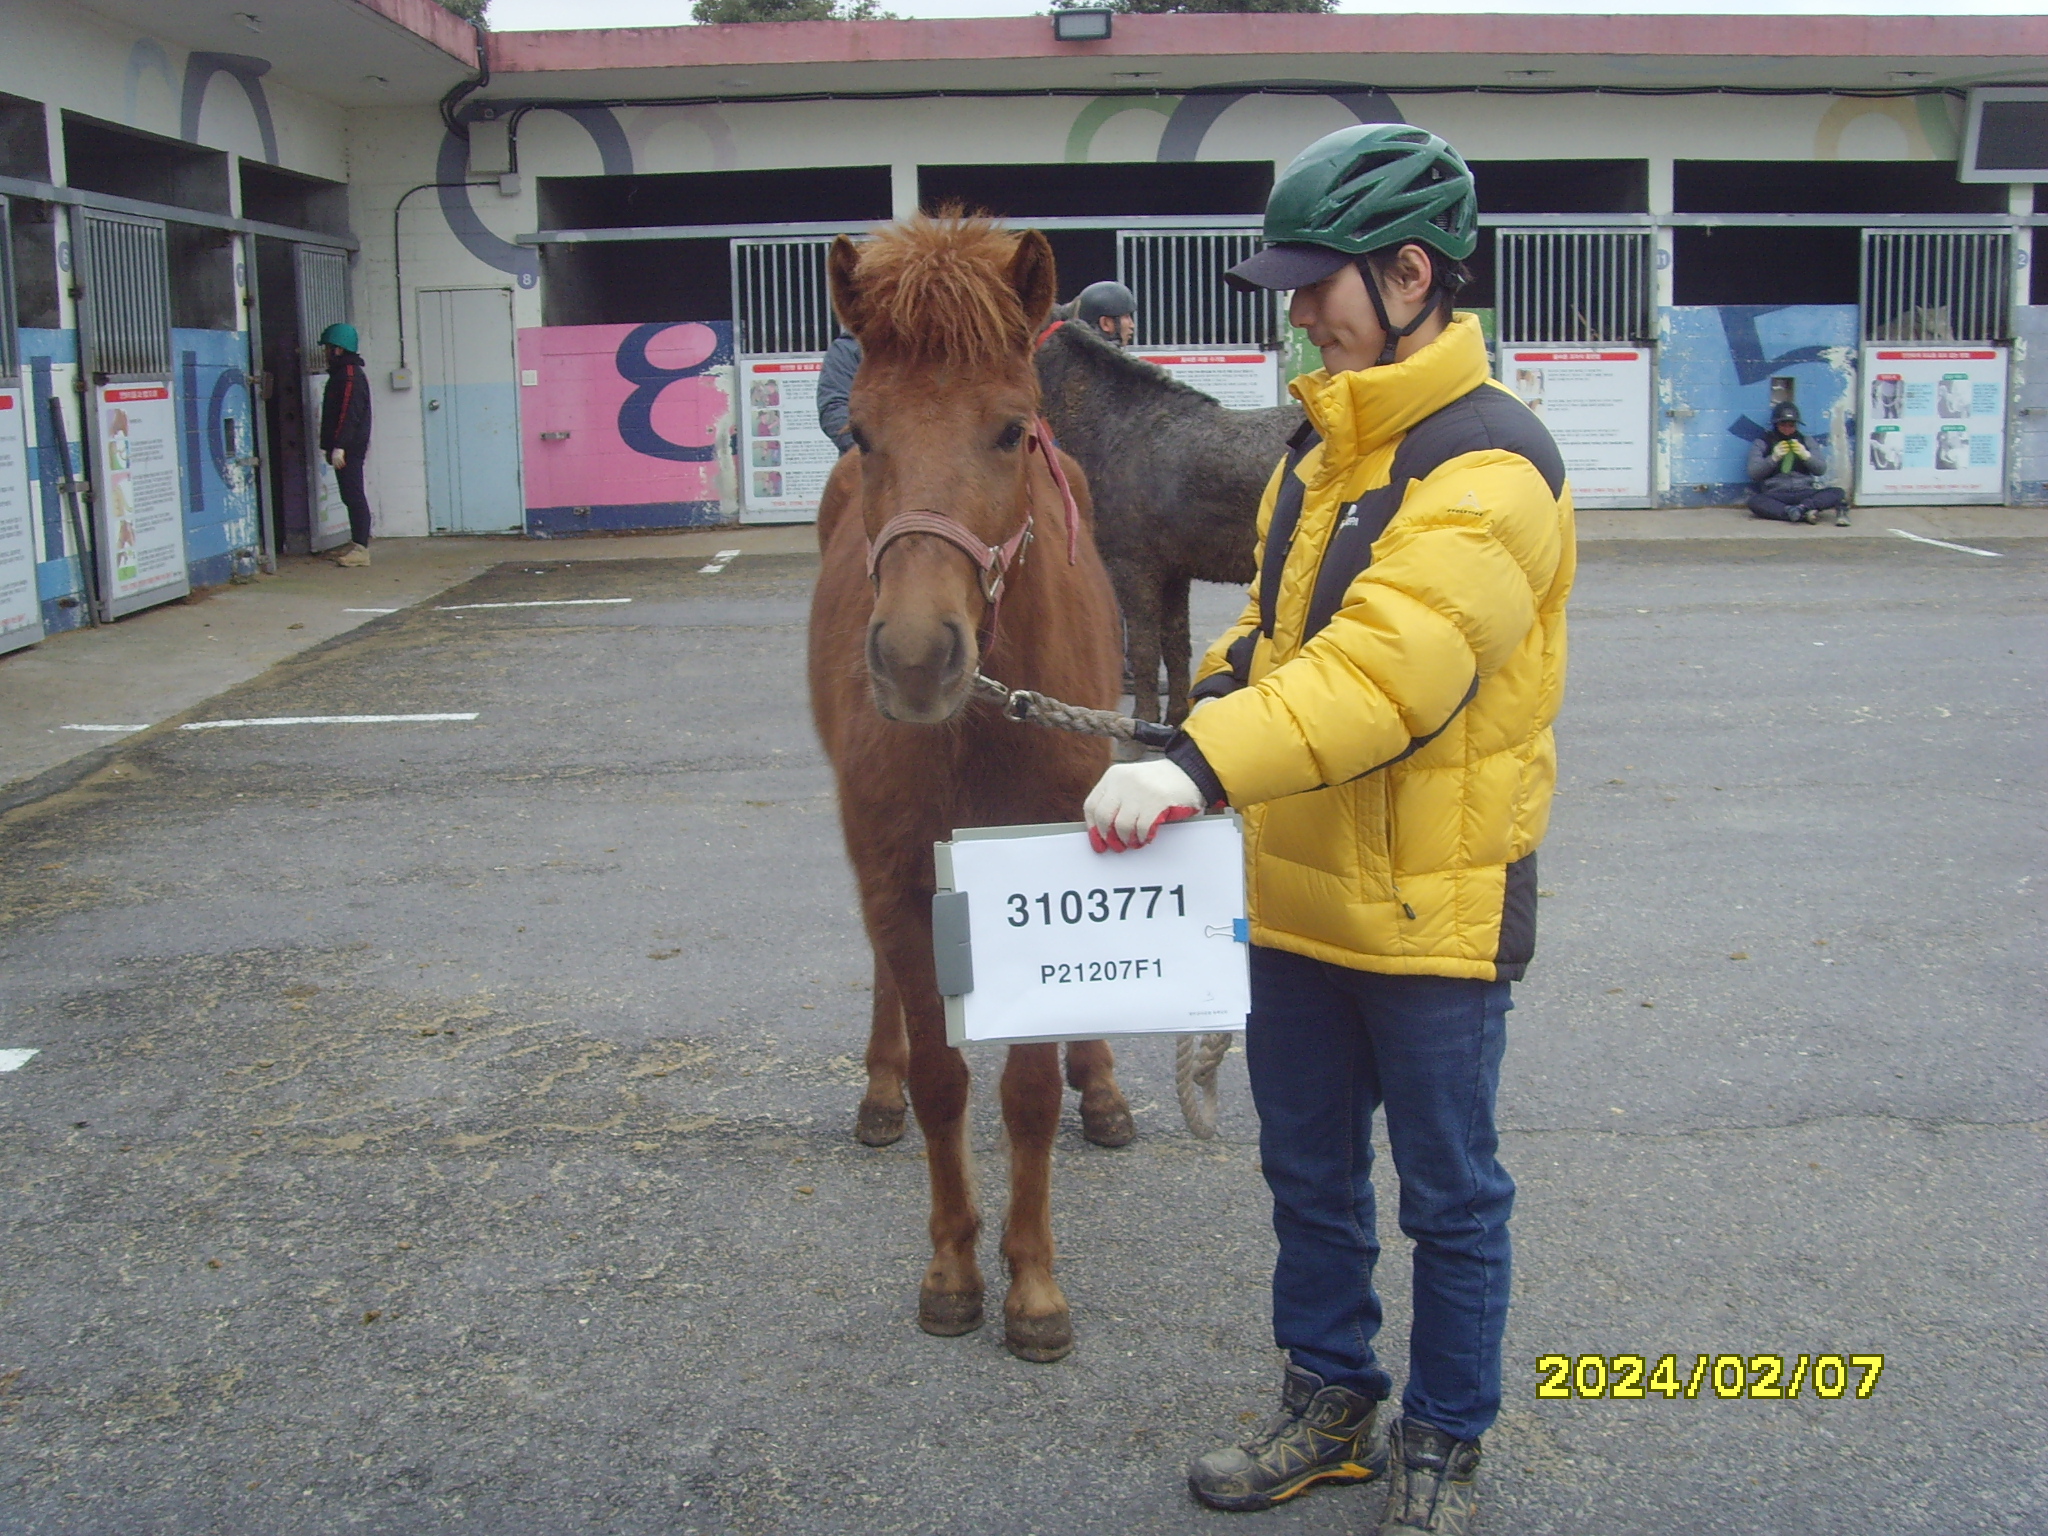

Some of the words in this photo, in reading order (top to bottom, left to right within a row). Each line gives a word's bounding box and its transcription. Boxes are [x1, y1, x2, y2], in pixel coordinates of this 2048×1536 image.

[522, 273, 532, 286] 8
[1006, 884, 1186, 928] 3103771
[1040, 958, 1163, 985] P21207F1
